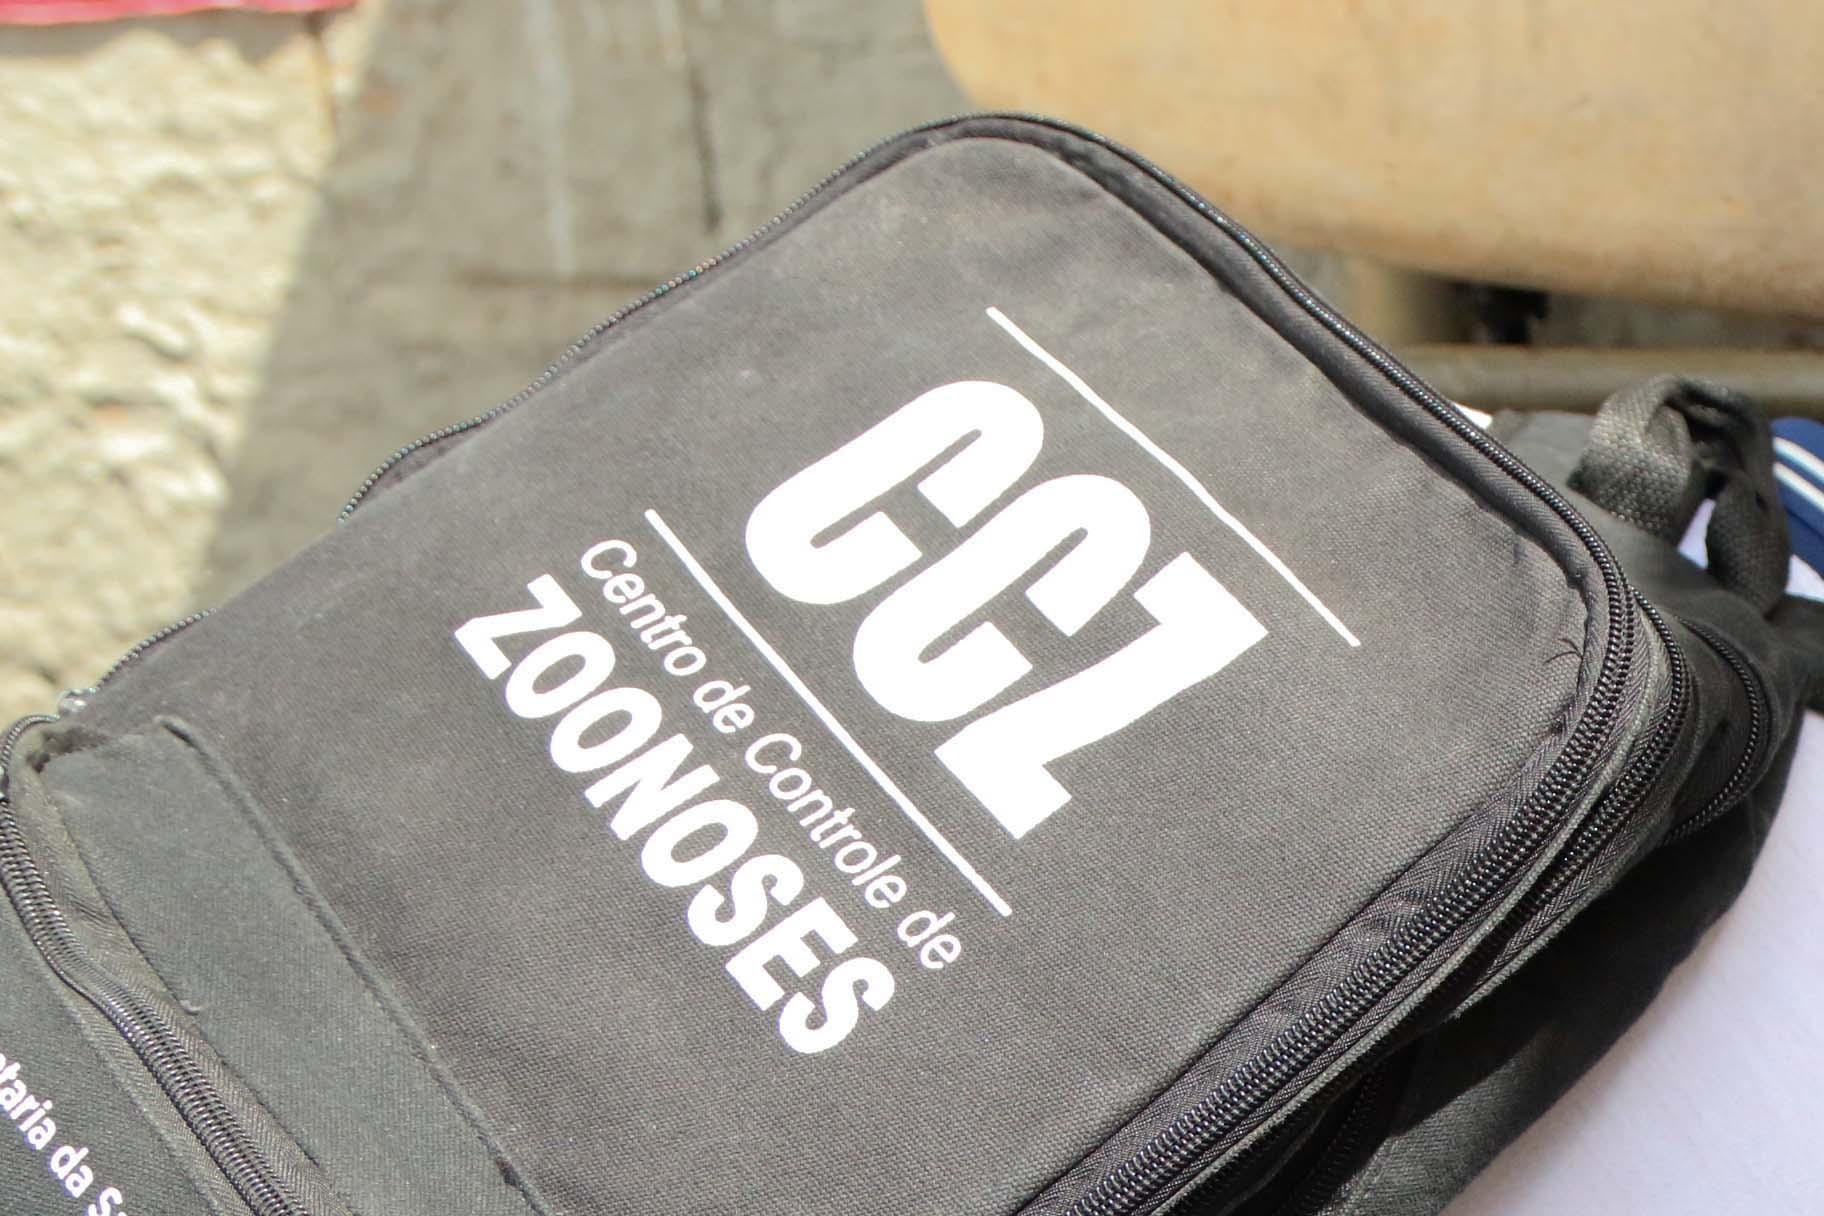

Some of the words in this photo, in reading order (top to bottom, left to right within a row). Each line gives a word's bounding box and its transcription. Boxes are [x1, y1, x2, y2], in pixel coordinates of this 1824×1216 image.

[454, 573, 896, 1055] ZOONOSES
[580, 539, 708, 677] Centro
[692, 679, 756, 735] de
[744, 732, 908, 909] Controle
[896, 909, 962, 970] de
[743, 378, 1270, 841] CCZ
[0, 1053, 57, 1150] taria
[50, 1144, 94, 1198] da
